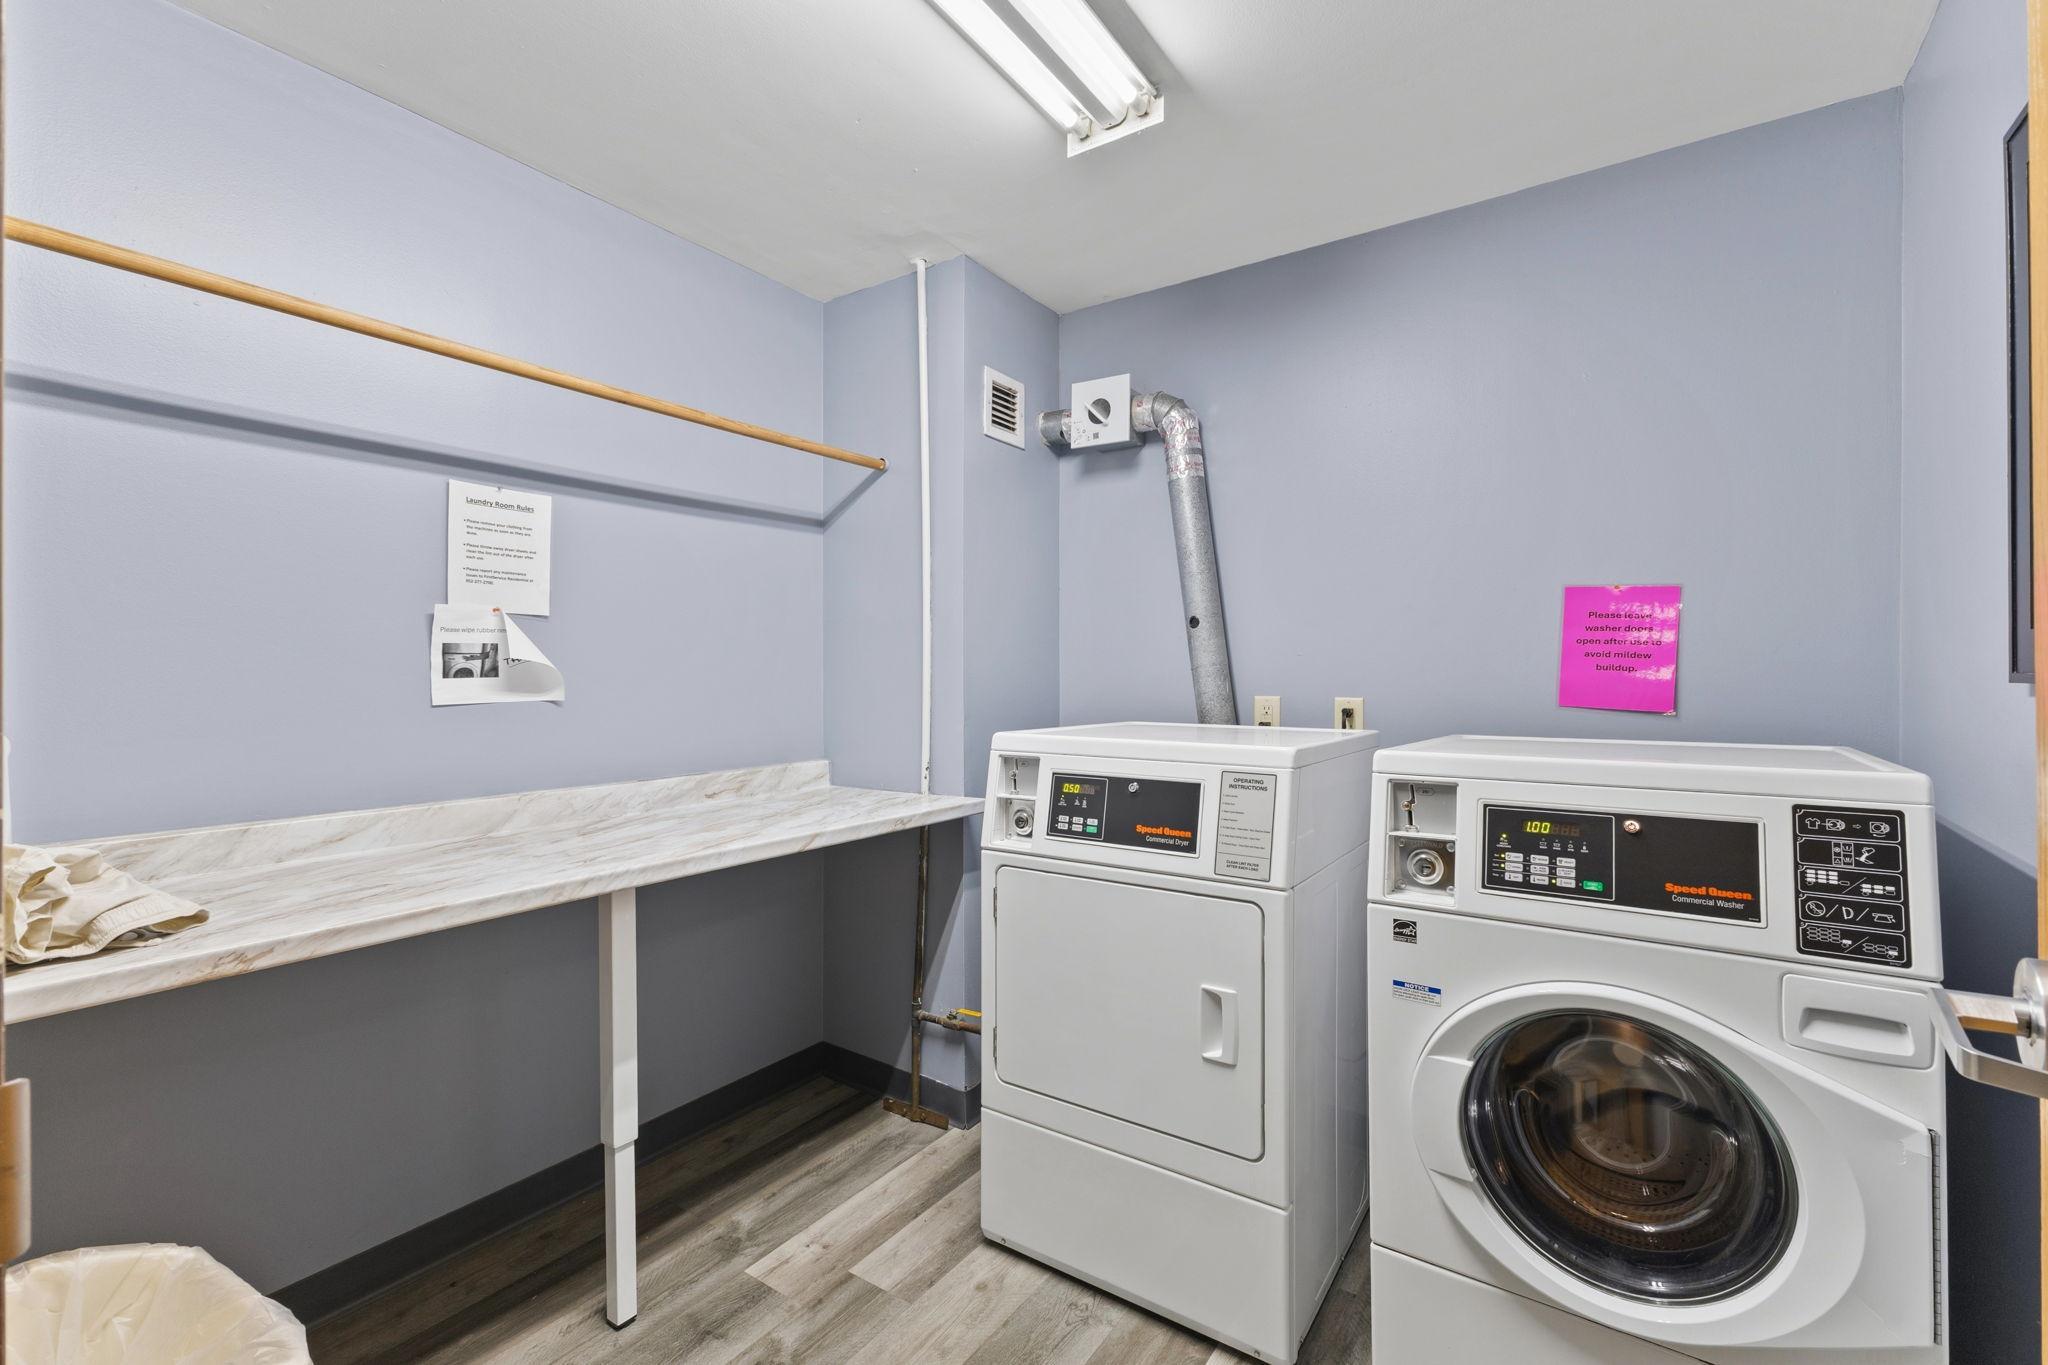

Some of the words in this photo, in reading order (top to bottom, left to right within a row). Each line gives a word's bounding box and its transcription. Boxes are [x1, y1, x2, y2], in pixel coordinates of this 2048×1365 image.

[465, 496, 493, 507] Laundry
[495, 502, 514, 510] Room
[516, 504, 534, 513] Rules
[1588, 611, 1622, 619] Please
[1576, 638, 1600, 646] open
[1613, 651, 1652, 659] mildew
[1595, 664, 1638, 673] buildup.
[1233, 777, 1264, 785] OPERATING
[1229, 784, 1268, 792] INSTRUCTIONS
[1136, 824, 1162, 836] Speed
[1163, 826, 1192, 838] Queen
[1145, 835, 1174, 845] Commercial
[1175, 838, 1189, 847] Dryer
[1664, 882, 1707, 896] Speed
[1708, 887, 1753, 900] Queen
[1672, 894, 1714, 906] Commercial
[1717, 900, 1744, 910] Washer
[1404, 982, 1430, 992] NOTICE
